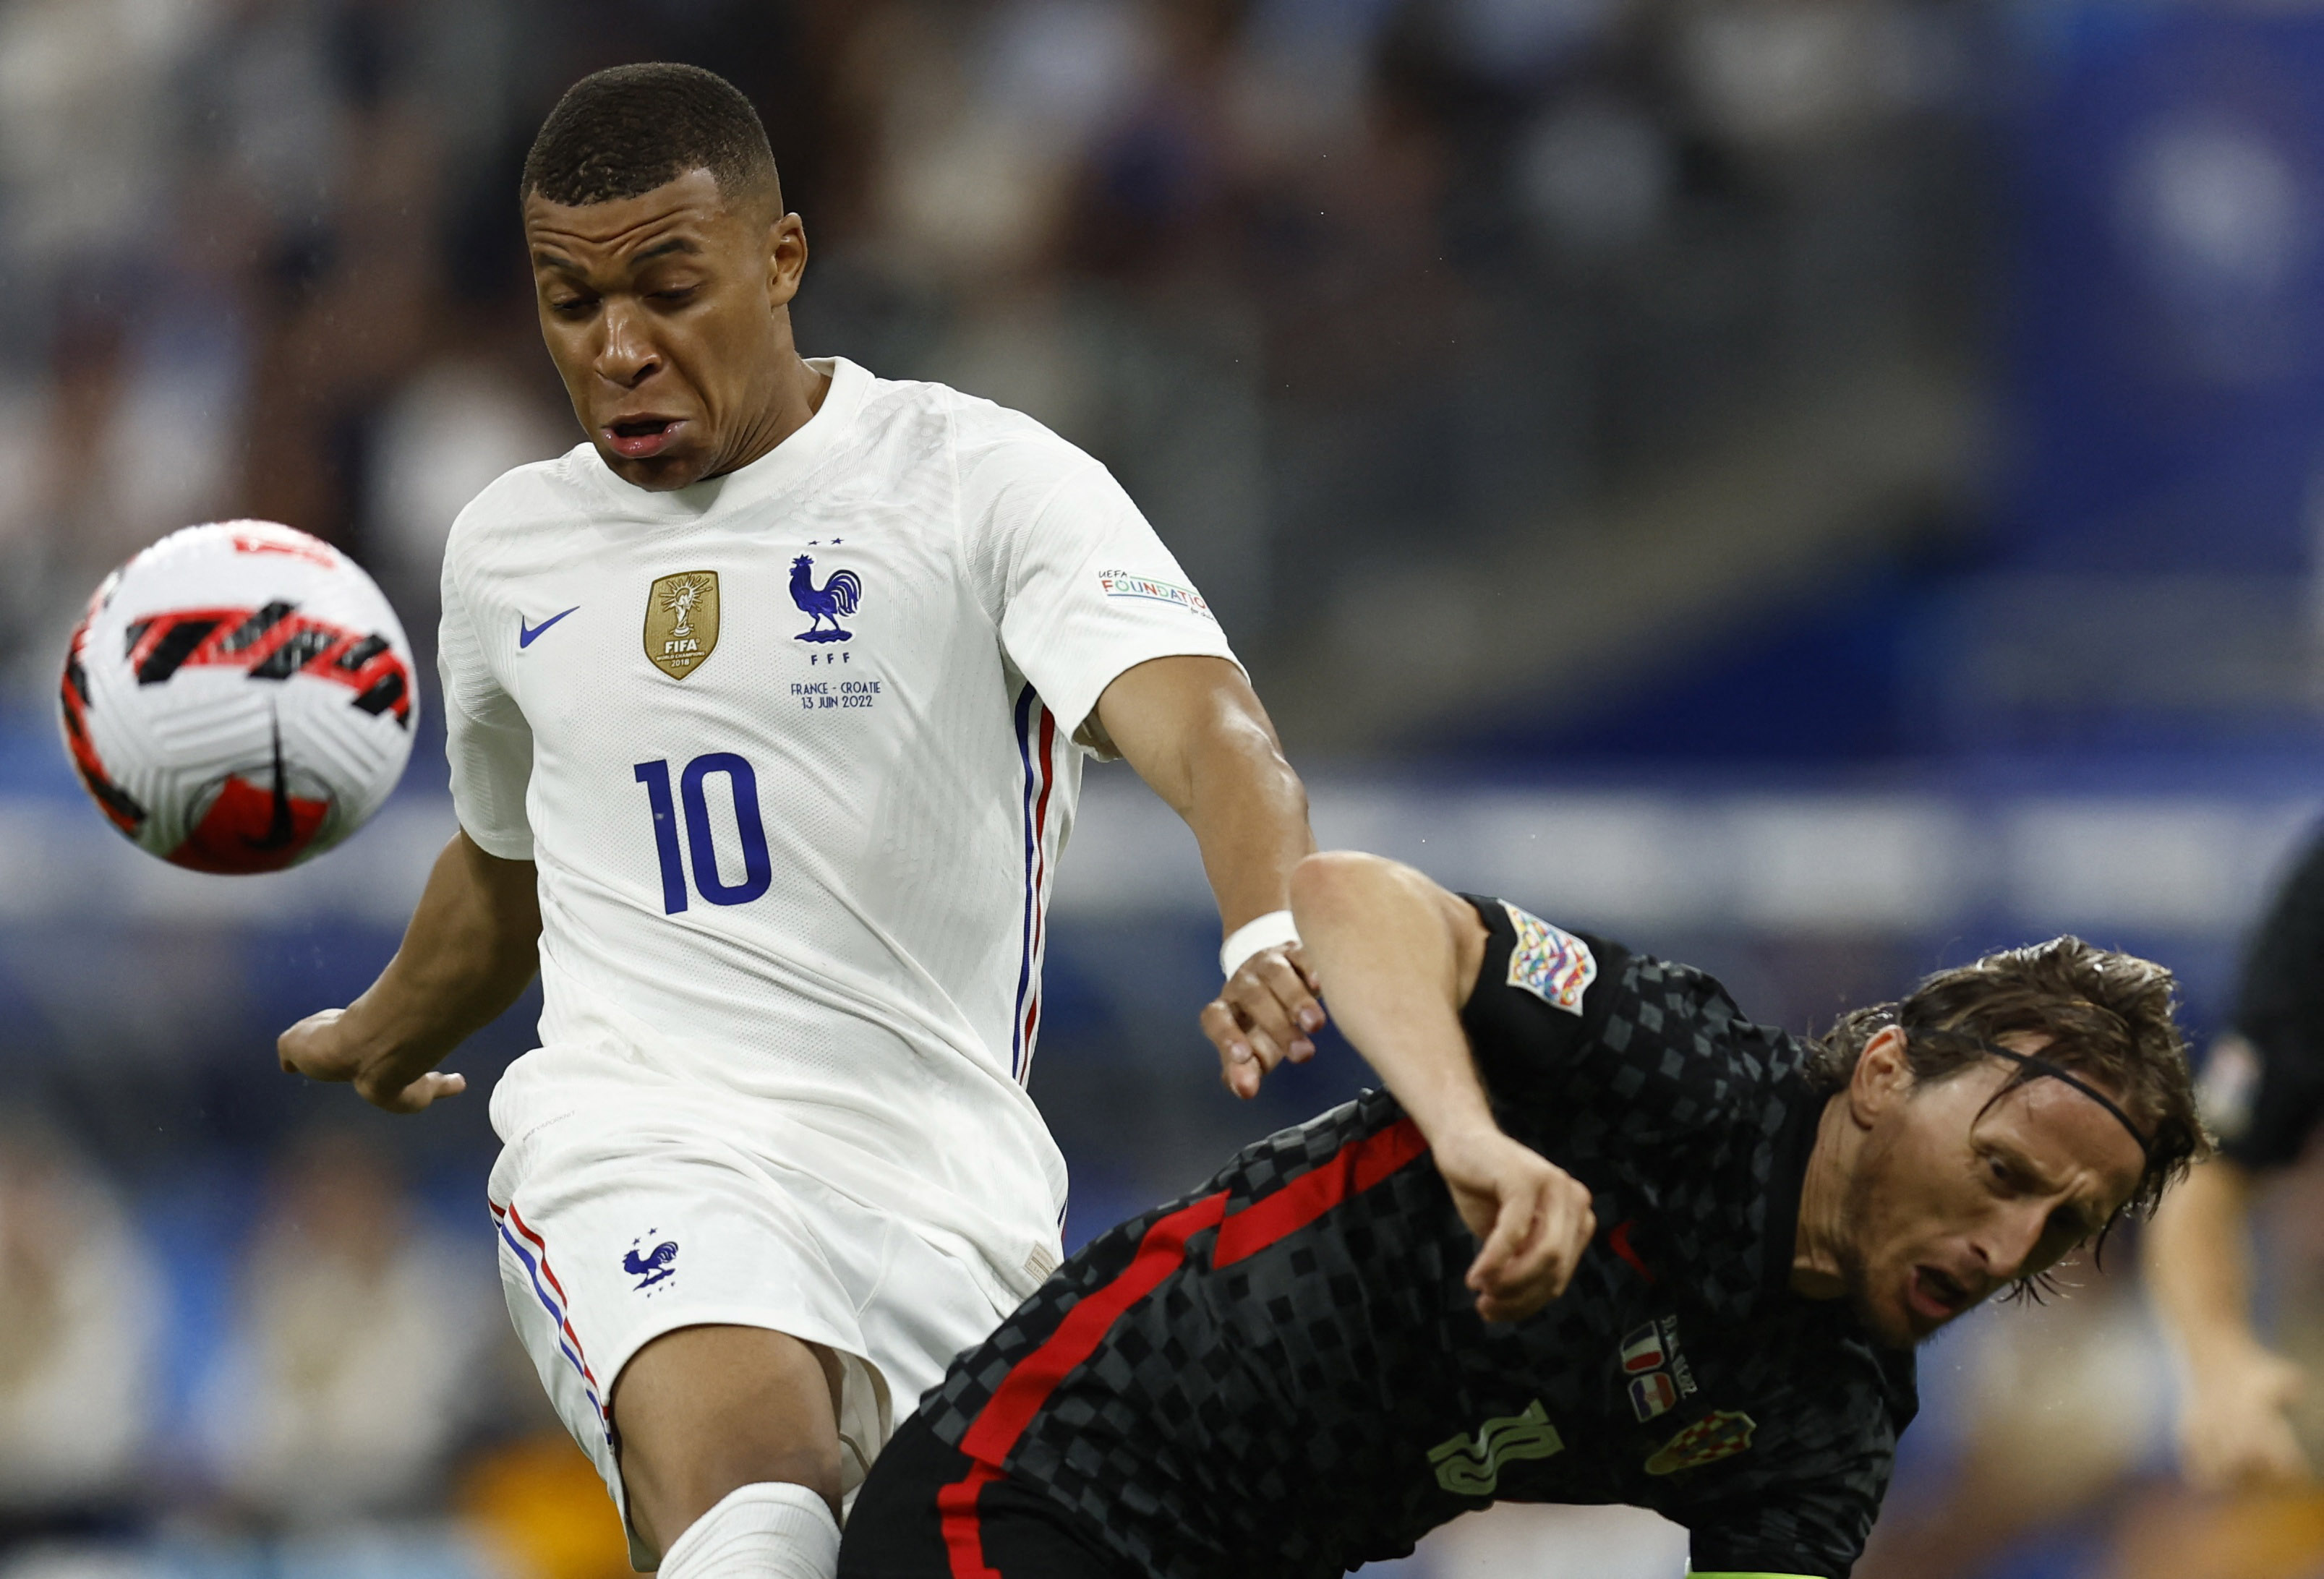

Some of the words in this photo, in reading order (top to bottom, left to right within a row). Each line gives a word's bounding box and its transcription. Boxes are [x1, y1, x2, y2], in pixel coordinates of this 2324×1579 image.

[1098, 570, 1128, 578] UEFA
[1101, 579, 1205, 609] FOUNDATIO
[665, 638, 698, 654] FIFA
[670, 659, 690, 667] 2018
[790, 682, 829, 696] FRANCE
[840, 681, 881, 694] CROATIE
[801, 696, 814, 709] 13
[818, 696, 839, 709] JUIN
[842, 694, 873, 708] 2022
[633, 752, 772, 915] 10
[1427, 1398, 1565, 1495] 10
